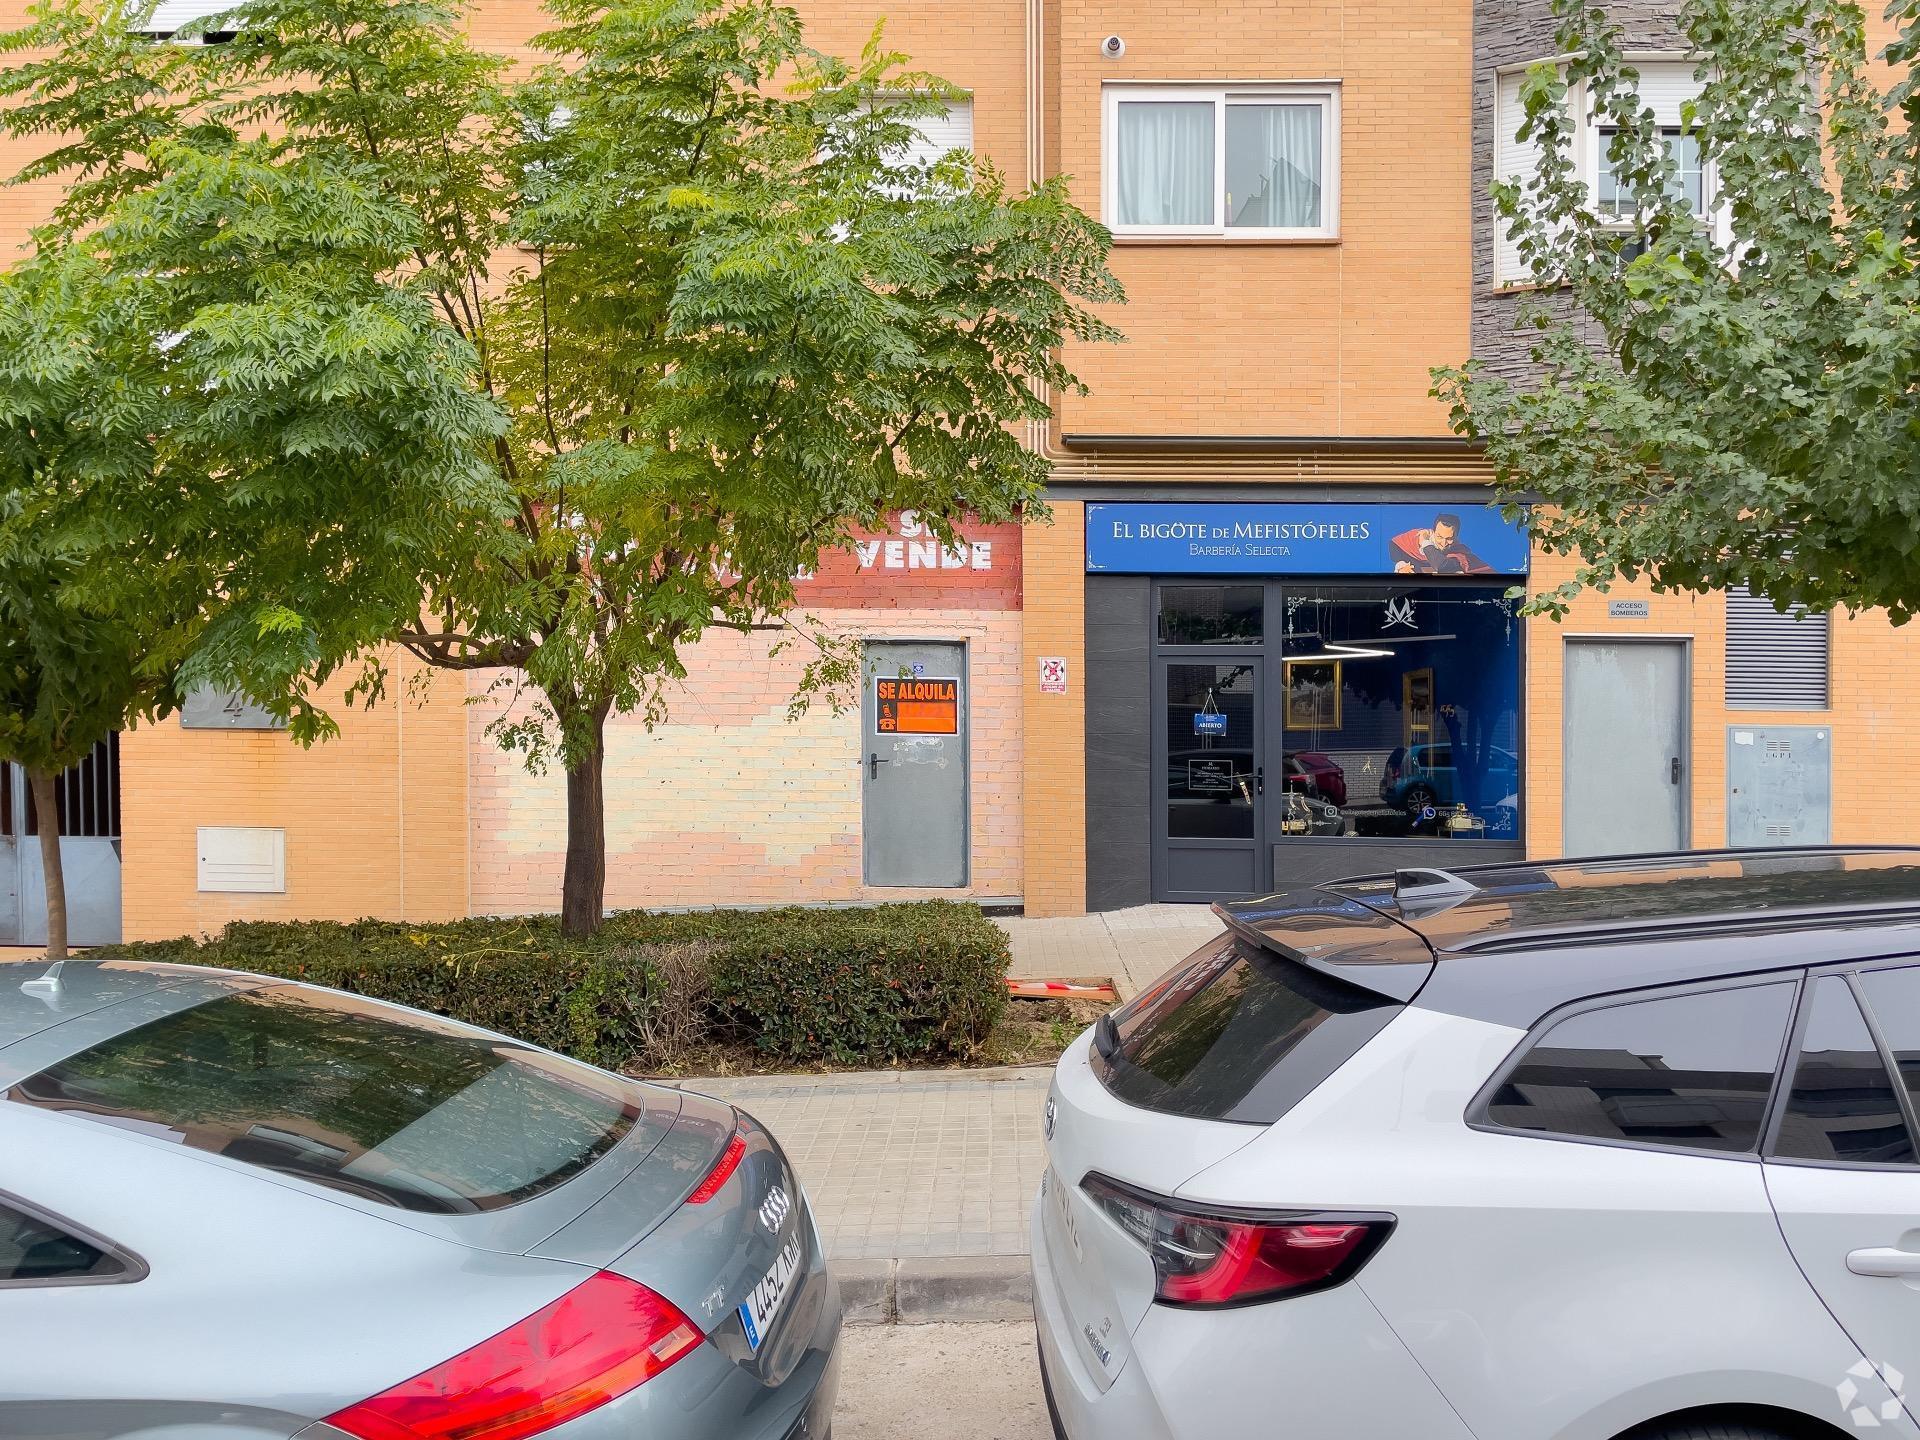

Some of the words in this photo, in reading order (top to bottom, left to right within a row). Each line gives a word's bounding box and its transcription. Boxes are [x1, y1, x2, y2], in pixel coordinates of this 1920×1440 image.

[1113, 521, 1134, 539] EL
[1212, 527, 1230, 539] DE
[1233, 521, 1370, 539] MEFISTÓFELES
[855, 540, 992, 569] VENDE
[1189, 543, 1242, 556] BARBERÍA
[1245, 543, 1291, 556] SELECTA
[879, 682, 896, 699] SE
[898, 682, 955, 700] ALQUILA
[223, 687, 244, 717] 4
